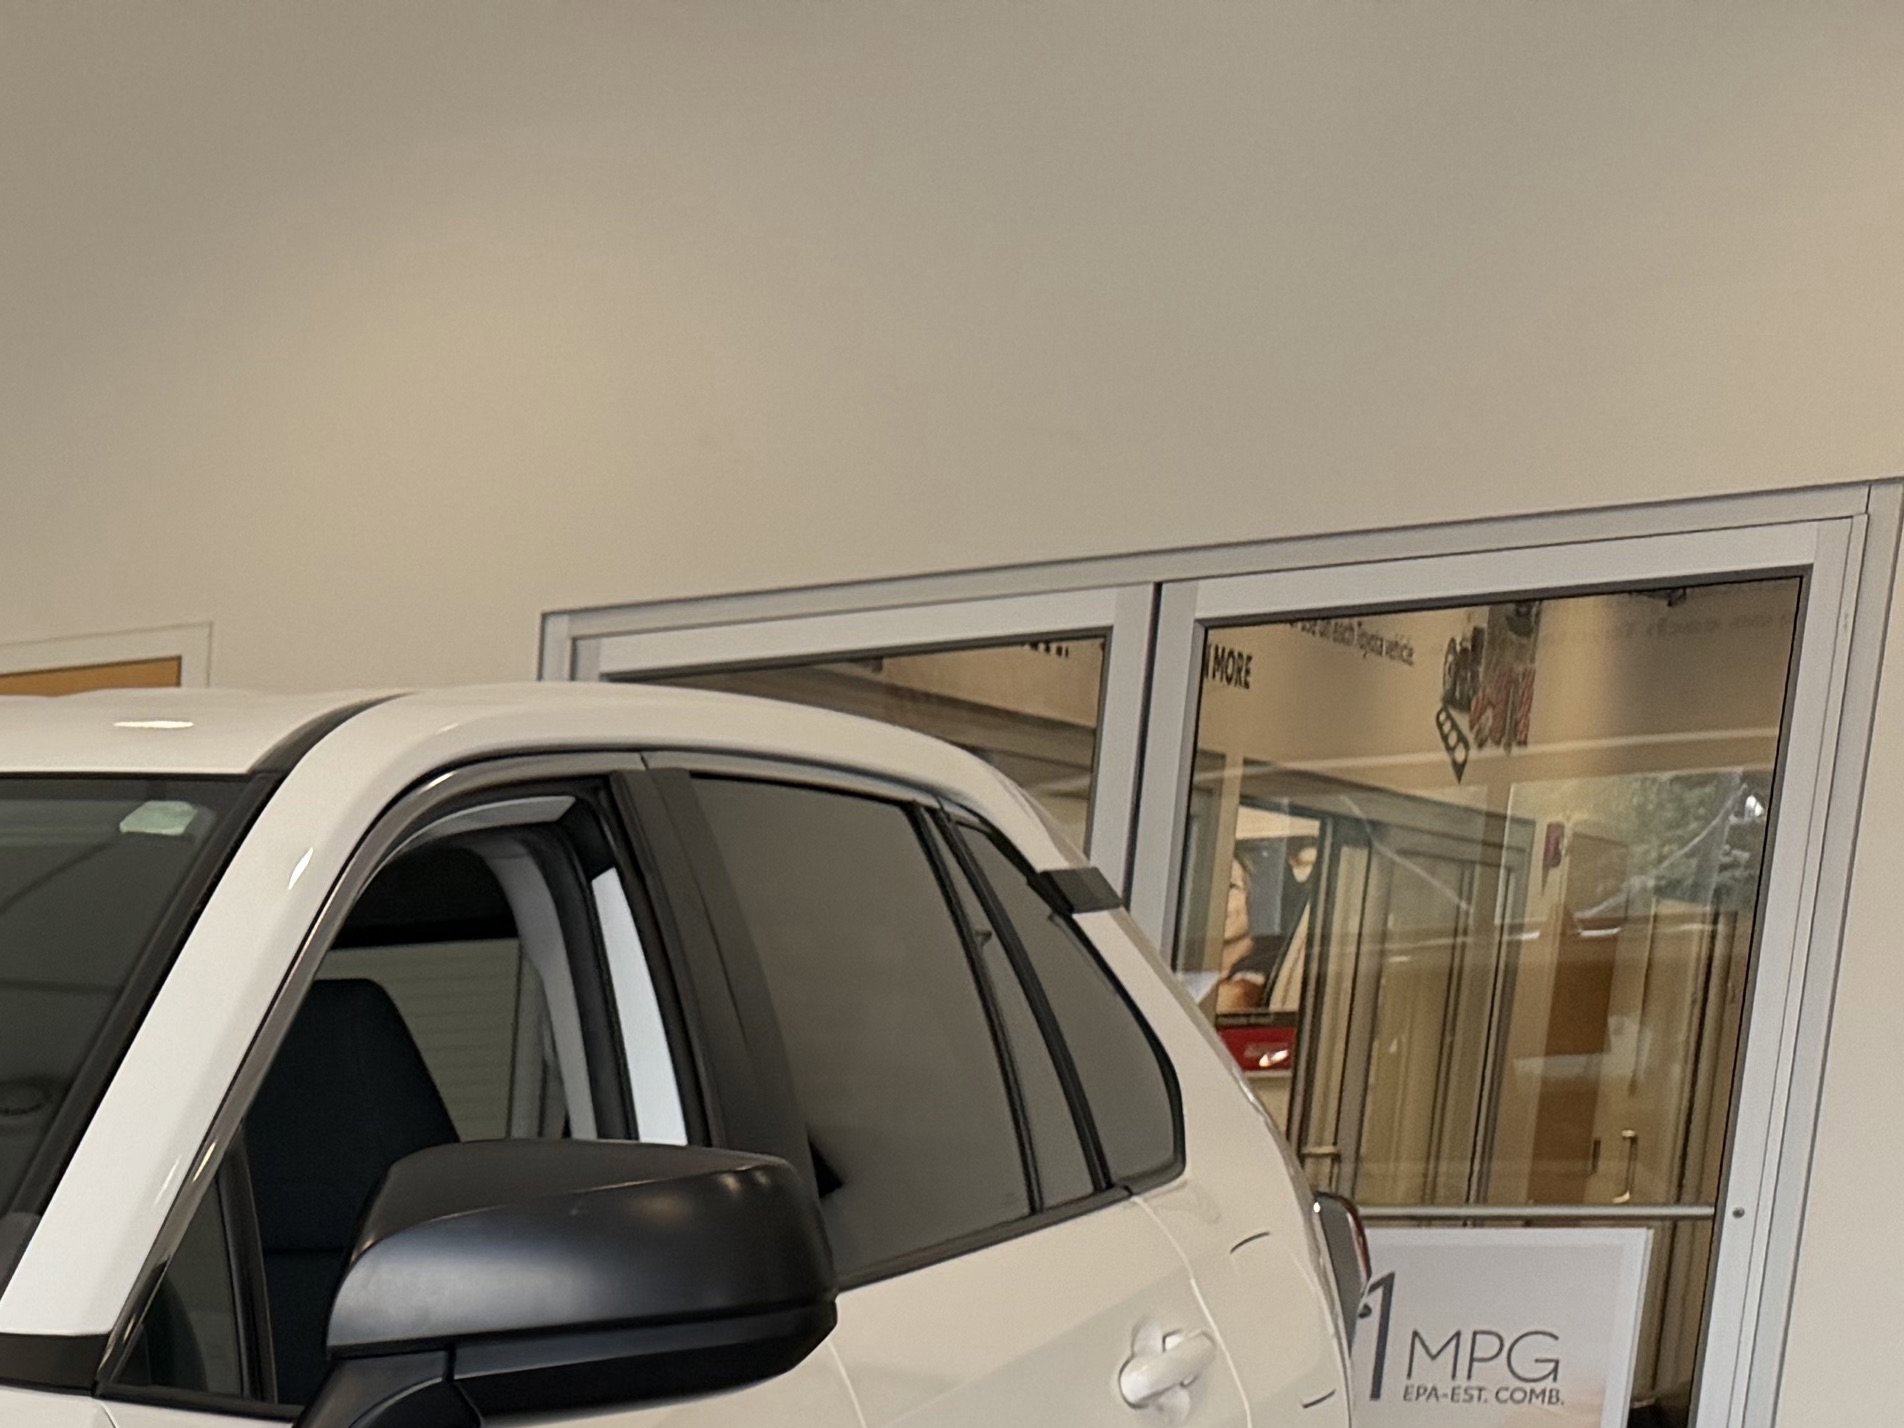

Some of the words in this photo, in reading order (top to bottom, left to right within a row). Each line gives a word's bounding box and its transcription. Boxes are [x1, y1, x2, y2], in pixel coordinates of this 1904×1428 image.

[1356, 620, 1384, 658] Toyota
[1212, 644, 1252, 690] MORE
[1406, 1329, 1560, 1384] MPG
[1403, 1384, 1487, 1404] EPA-EST.
[1494, 1385, 1565, 1406] COMB.
